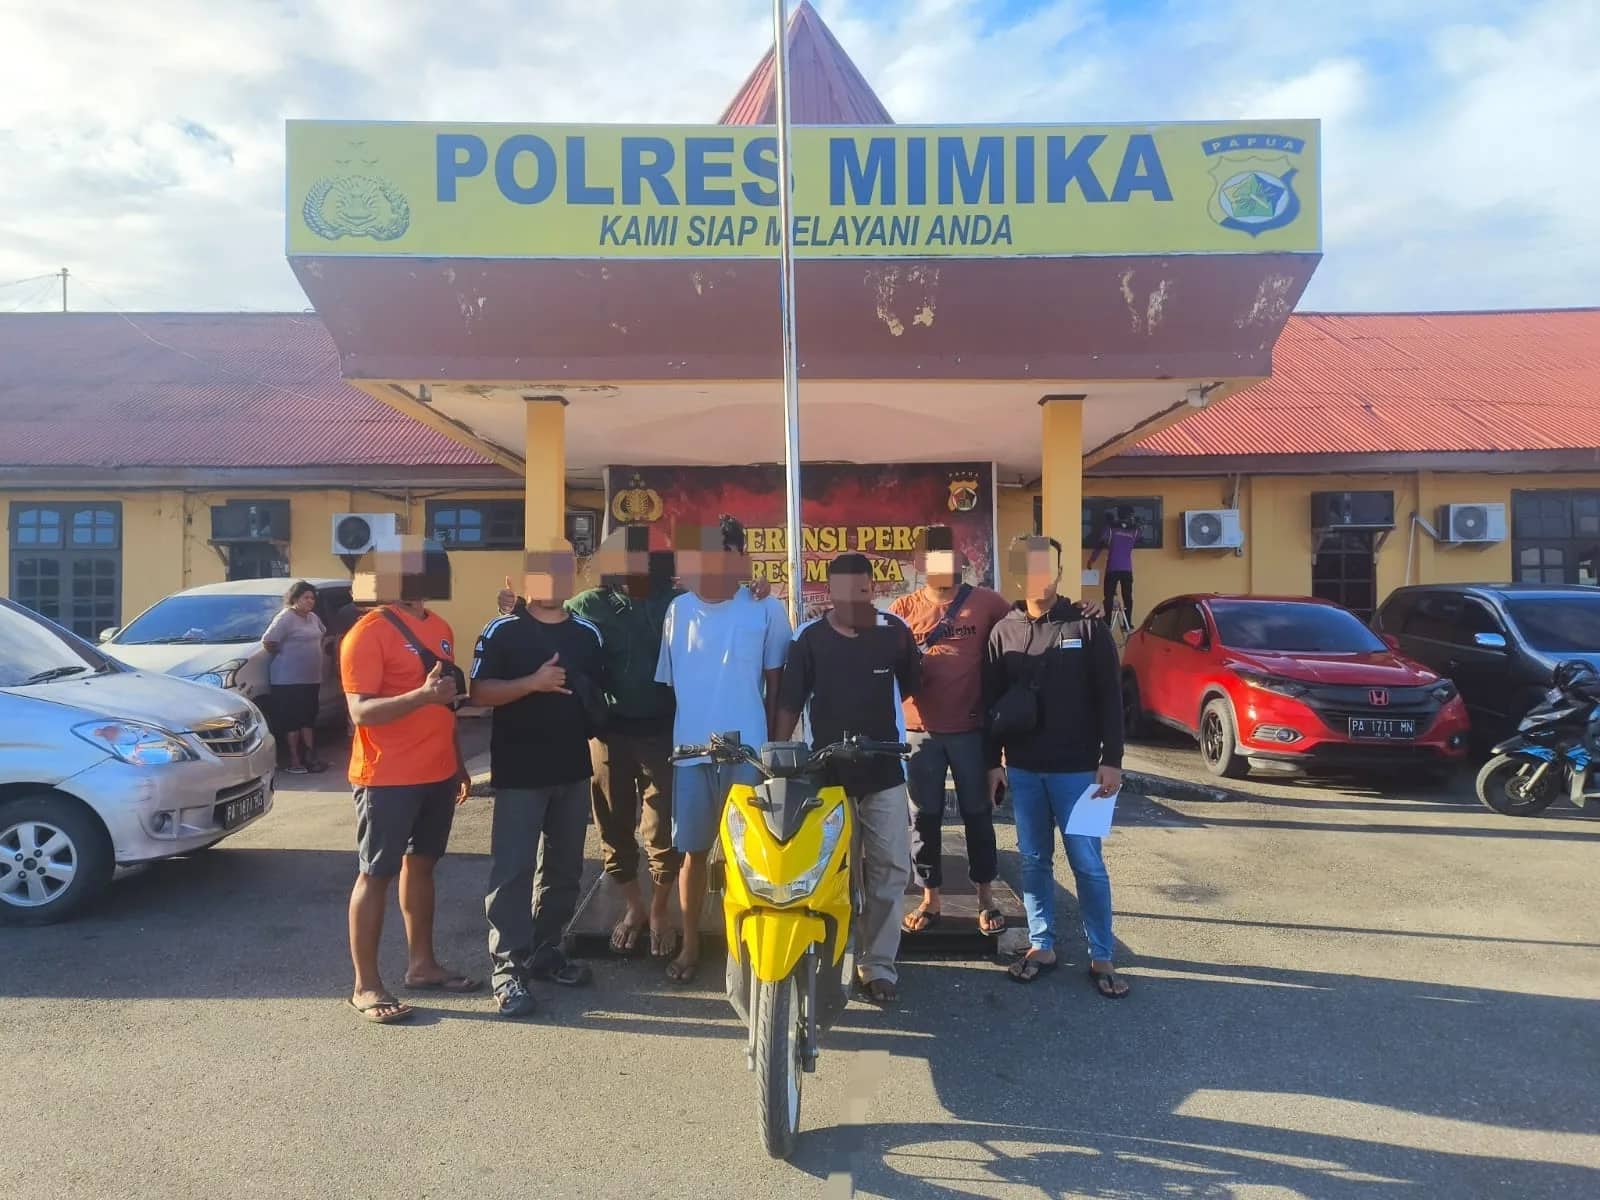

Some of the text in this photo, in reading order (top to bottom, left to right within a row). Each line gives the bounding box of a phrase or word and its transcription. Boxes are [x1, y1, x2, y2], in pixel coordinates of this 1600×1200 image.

[1211, 137, 1294, 151] PAPUA
[436, 133, 1174, 206] POLRES MIMIKA
[600, 214, 678, 246] KAMI
[687, 215, 759, 246] SIAP
[926, 214, 1012, 245] ANDA
